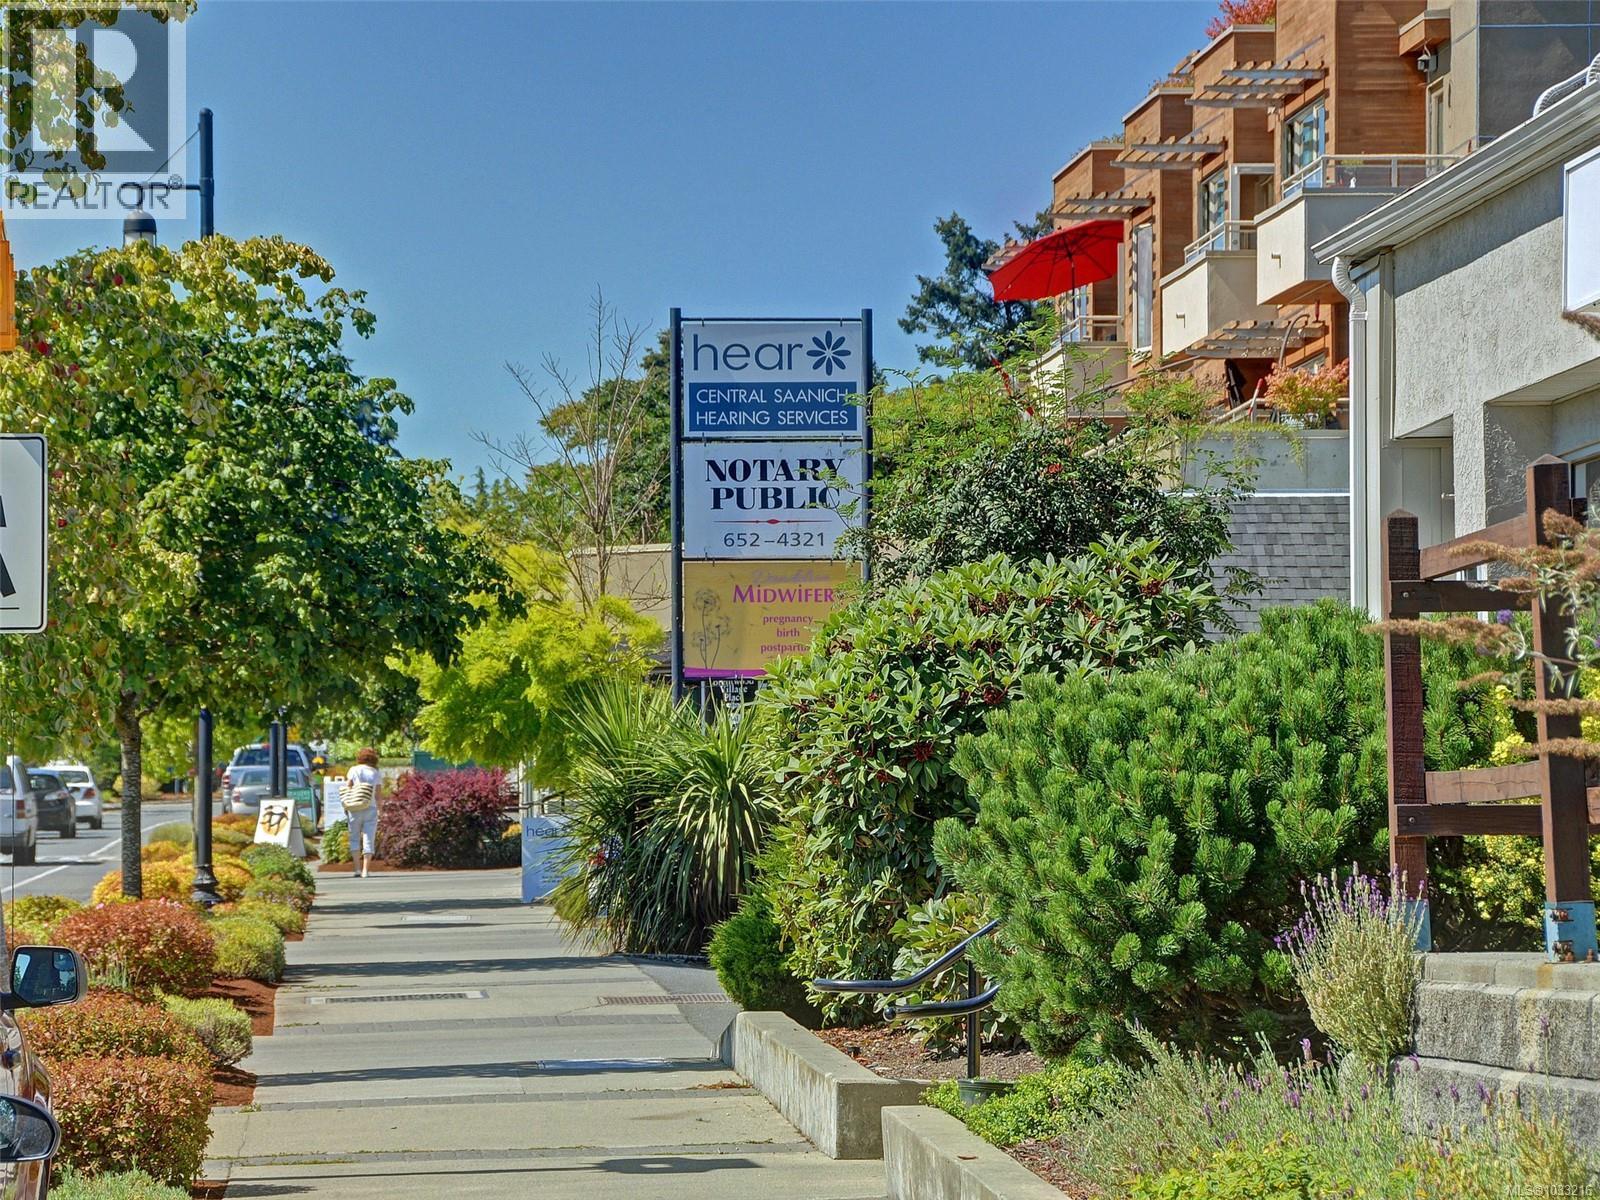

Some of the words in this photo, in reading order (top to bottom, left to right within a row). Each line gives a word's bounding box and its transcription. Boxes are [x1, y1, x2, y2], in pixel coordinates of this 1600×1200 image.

[693, 334, 804, 371] hear
[696, 388, 768, 404] CENTRAL
[774, 388, 849, 404] SAANICH
[696, 410, 771, 426] HEARING
[777, 410, 849, 425] SERVICES
[704, 458, 846, 482] NOTARY
[710, 486, 841, 510] PUBLIC
[723, 532, 825, 548] 652-4321
[762, 615, 814, 626] pregnancy
[776, 627, 800, 638] birth
[720, 685, 748, 694] Villae
[724, 693, 743, 702] Plac
[526, 825, 560, 838] hear
